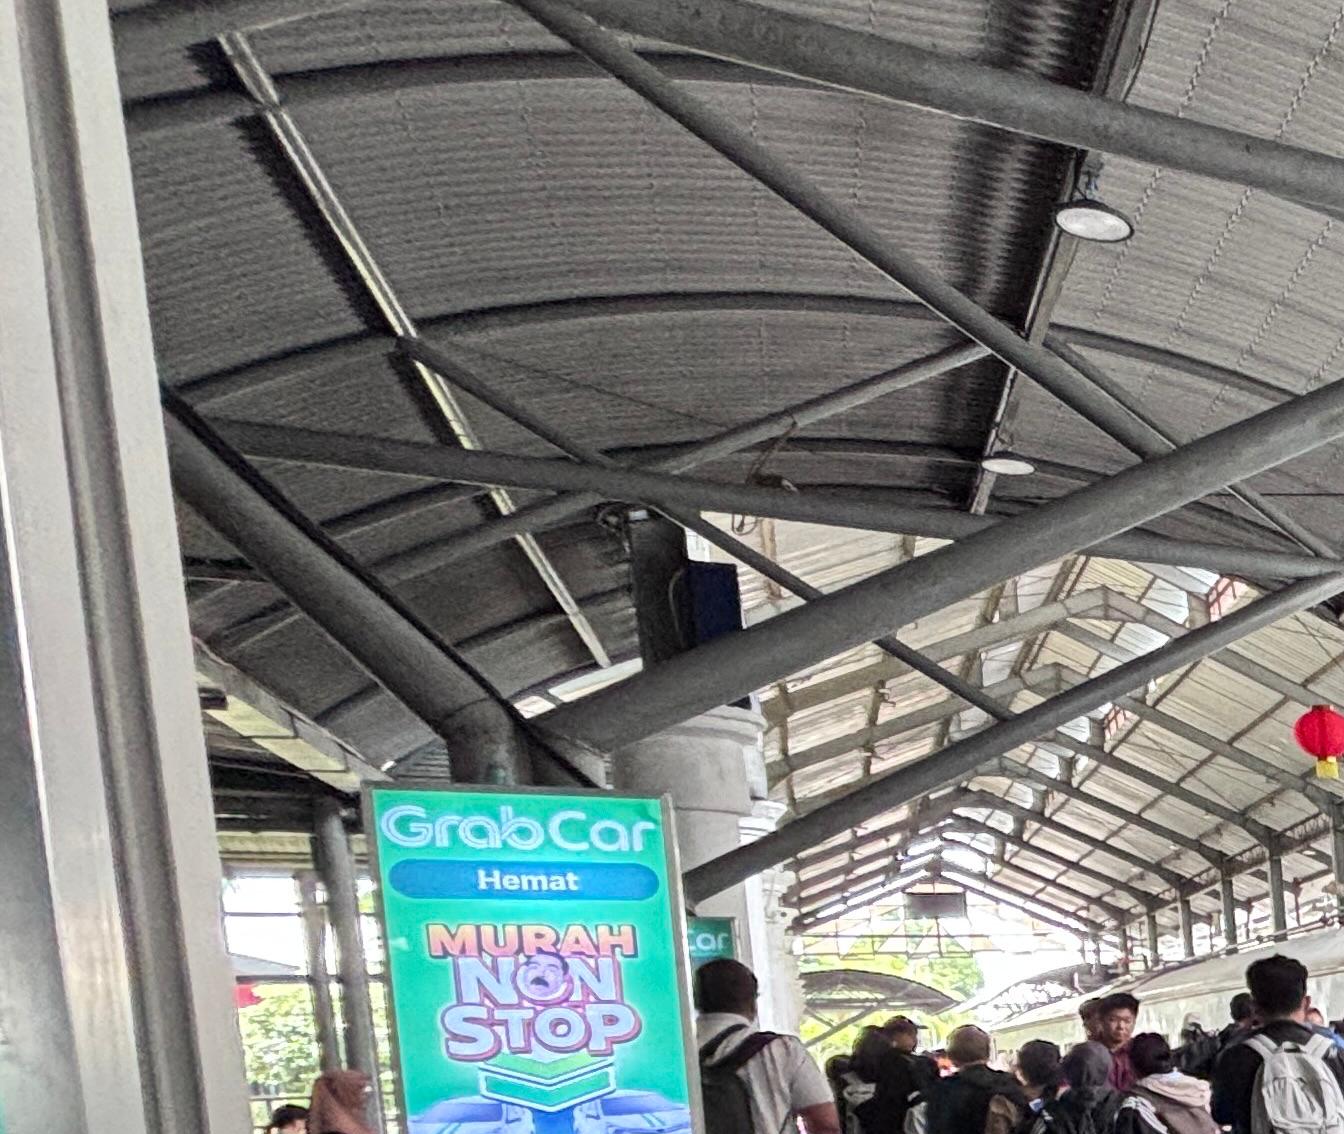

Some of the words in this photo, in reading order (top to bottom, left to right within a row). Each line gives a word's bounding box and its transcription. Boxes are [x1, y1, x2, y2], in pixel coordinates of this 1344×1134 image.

[477, 869, 578, 892] Hemat
[427, 924, 638, 957] MURAH
[441, 1003, 642, 1060] STOP
